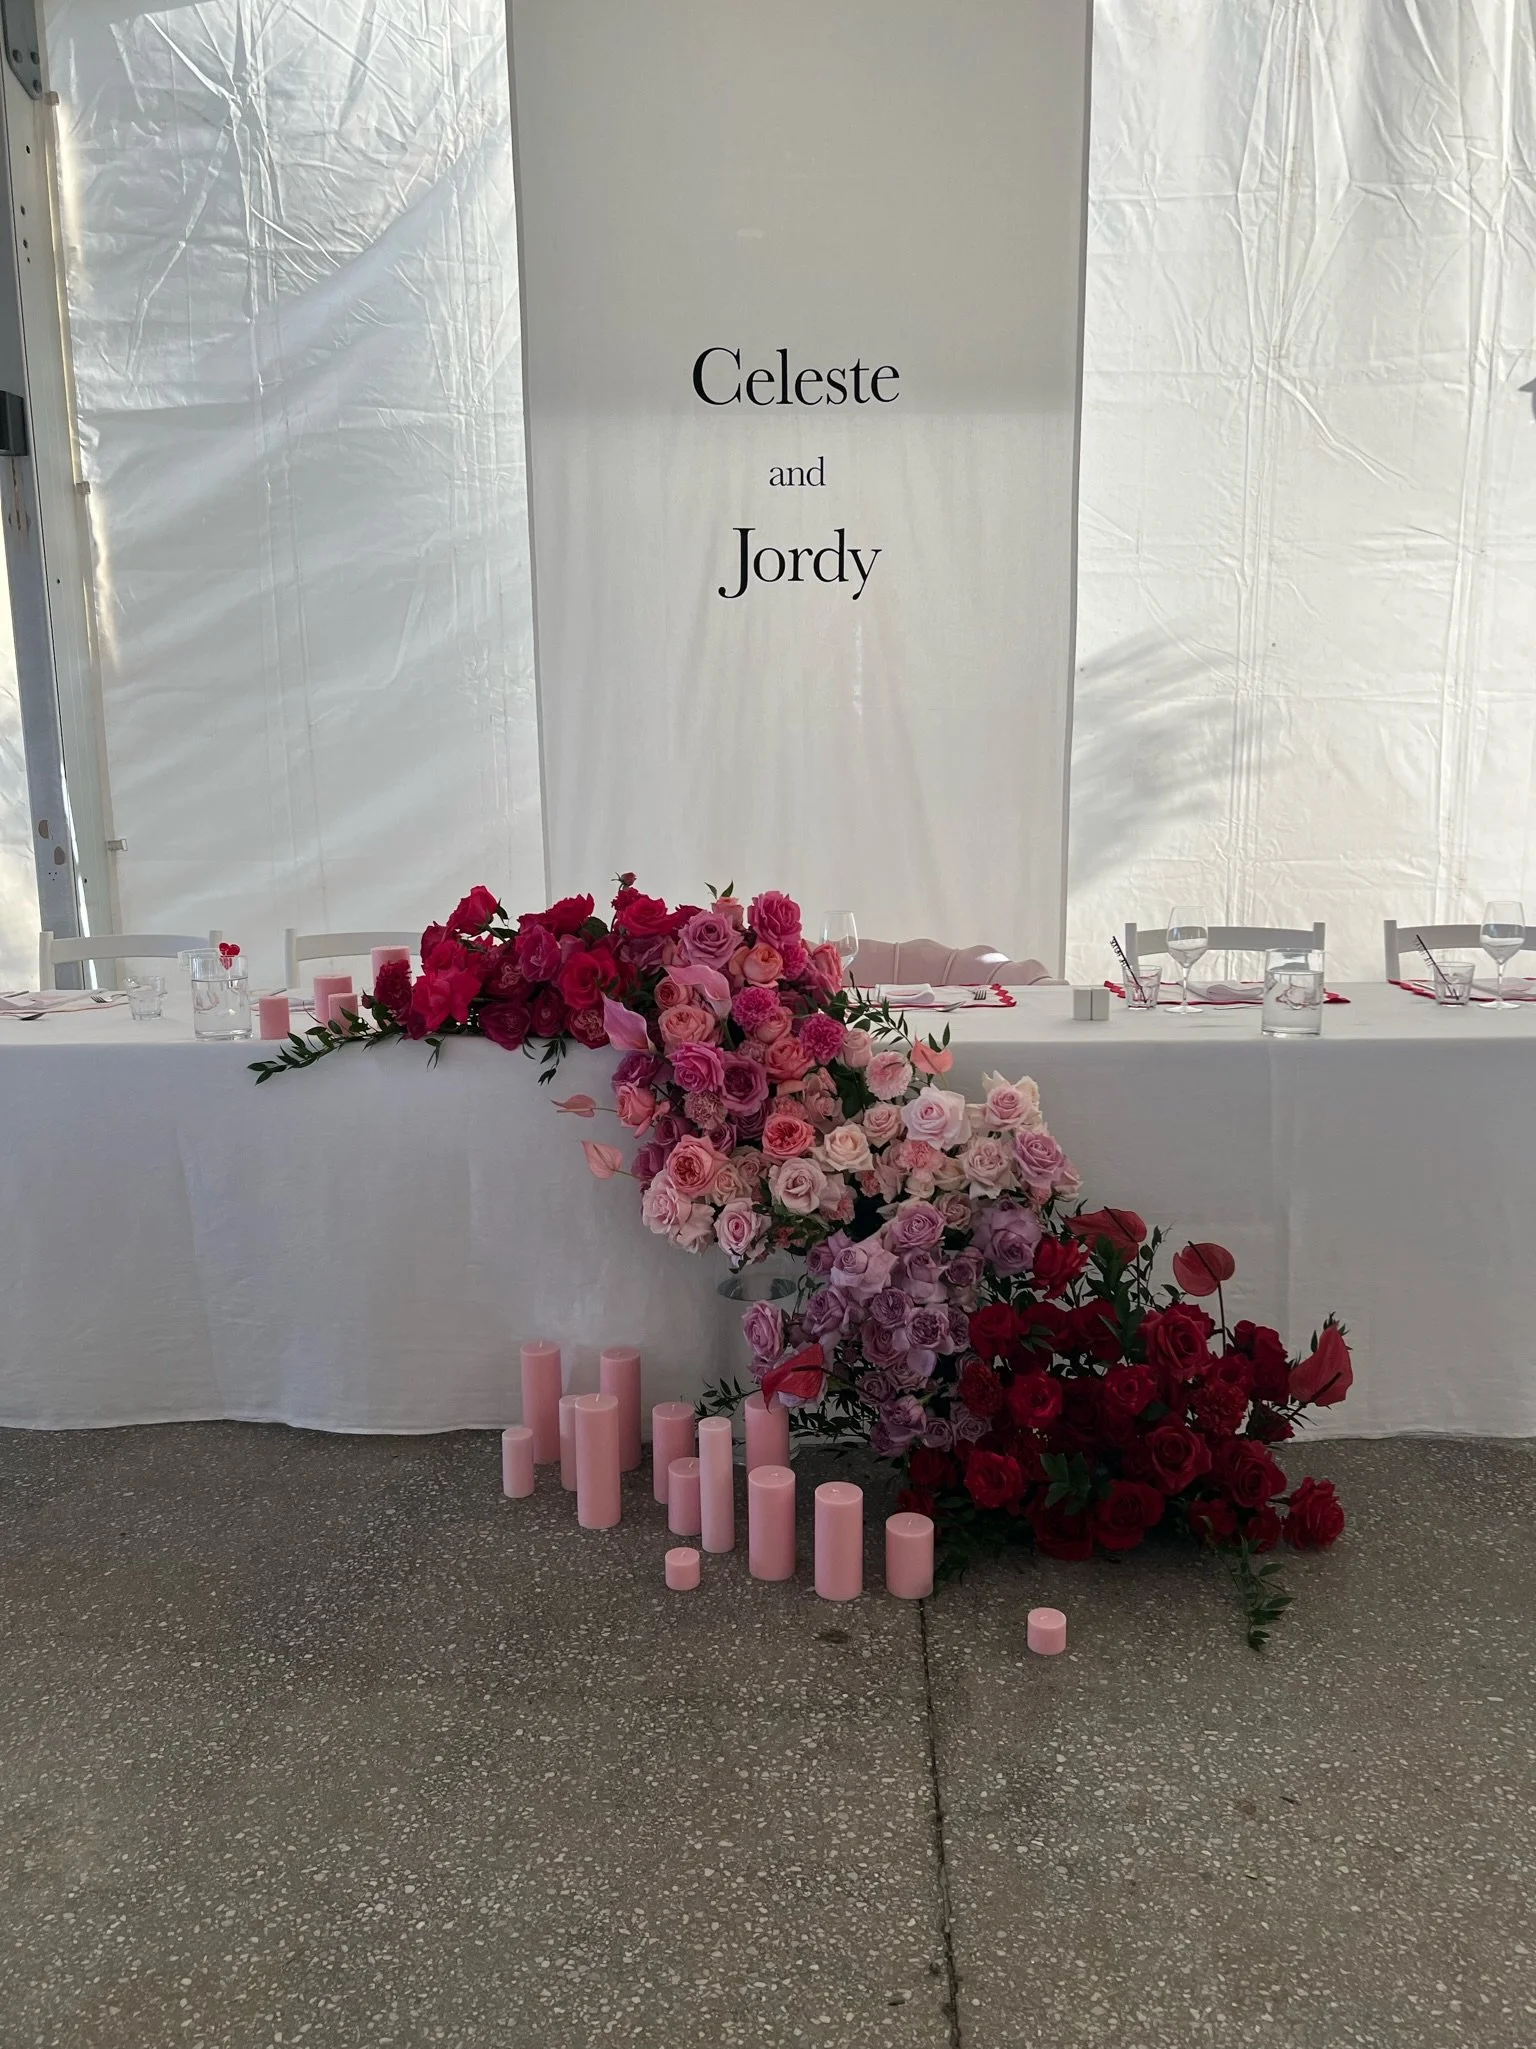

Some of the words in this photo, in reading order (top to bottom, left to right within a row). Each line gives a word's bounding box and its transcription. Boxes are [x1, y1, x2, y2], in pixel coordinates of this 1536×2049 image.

[692, 347, 900, 406] Celeste
[769, 456, 826, 487] and
[718, 527, 883, 601] Jordy
